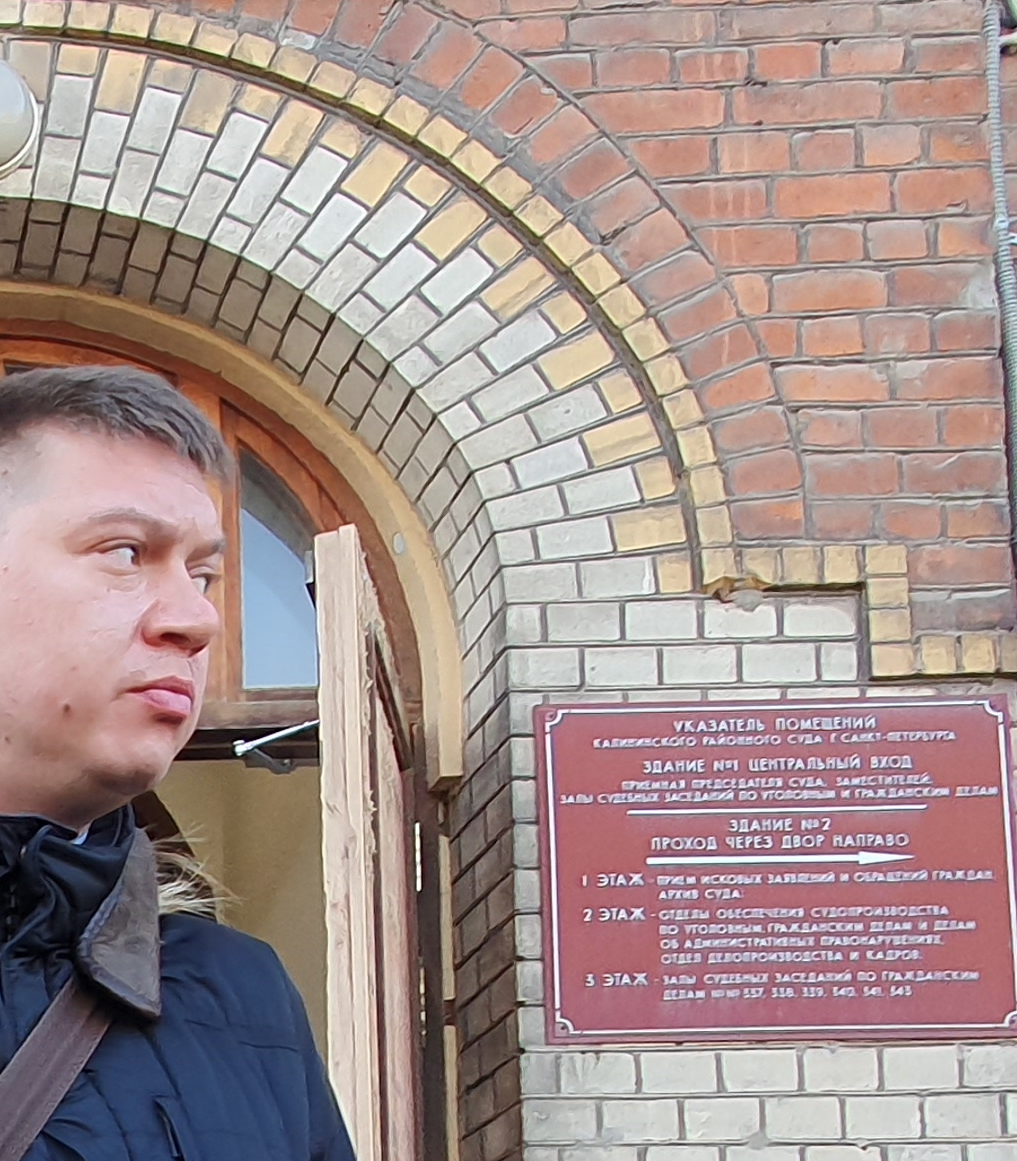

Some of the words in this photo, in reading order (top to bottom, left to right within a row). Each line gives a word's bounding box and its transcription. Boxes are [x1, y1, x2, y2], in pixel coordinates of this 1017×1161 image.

[673, 718, 765, 733] УКАЗАТЕЛЬ
[775, 714, 877, 731] ПОМЕЩЕНИЙ
[593, 737, 697, 749] КАЛИНИНСКОГО
[787, 734, 823, 745] СУДА
[643, 759, 706, 774] ЗДАНИЕ
[713, 760, 739, 772] №1
[749, 753, 861, 773] ЦЕНТРАЛЬНЫЙ
[870, 755, 914, 770] ВХОД
[729, 818, 794, 832] ЗДАНИЕ
[801, 818, 832, 831] №2
[651, 836, 718, 851] ПРОХОД
[725, 834, 774, 849] ЧЕРЕЗ
[781, 835, 826, 848] ДВОР
[833, 833, 910, 847] НАПРАВО
[582, 874, 588, 887] 1
[596, 873, 646, 887] ЭТАЖ
[583, 910, 593, 922] 2
[598, 908, 646, 922] ЭТАЖ
[585, 974, 595, 986] 3
[602, 972, 649, 986] ЭТАЖ
